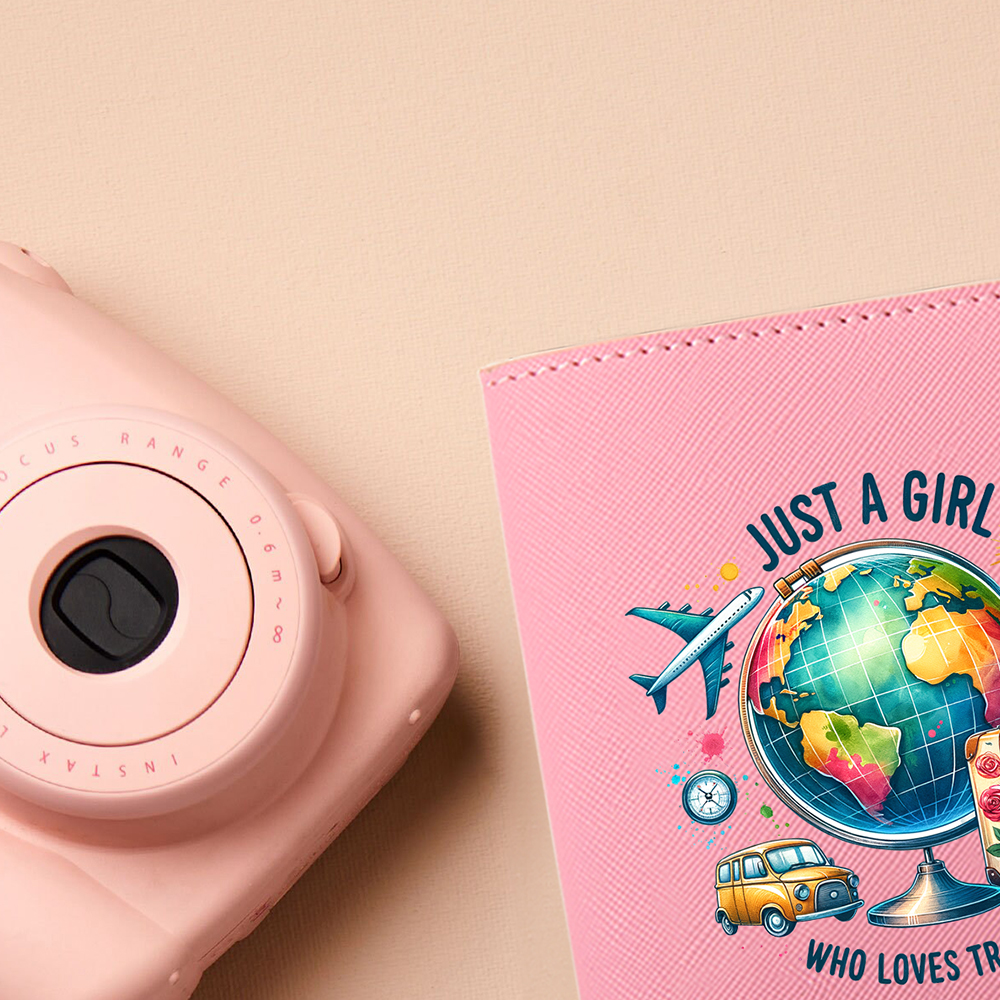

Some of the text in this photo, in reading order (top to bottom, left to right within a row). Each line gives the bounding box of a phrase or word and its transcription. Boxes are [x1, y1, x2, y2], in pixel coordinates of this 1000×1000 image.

[120, 432, 231, 490] RANGE
[746, 471, 994, 572] JUST A GIRL
[39, 751, 178, 778] INSTAX
[807, 939, 866, 981] WHO
[879, 950, 960, 985] LOVES
